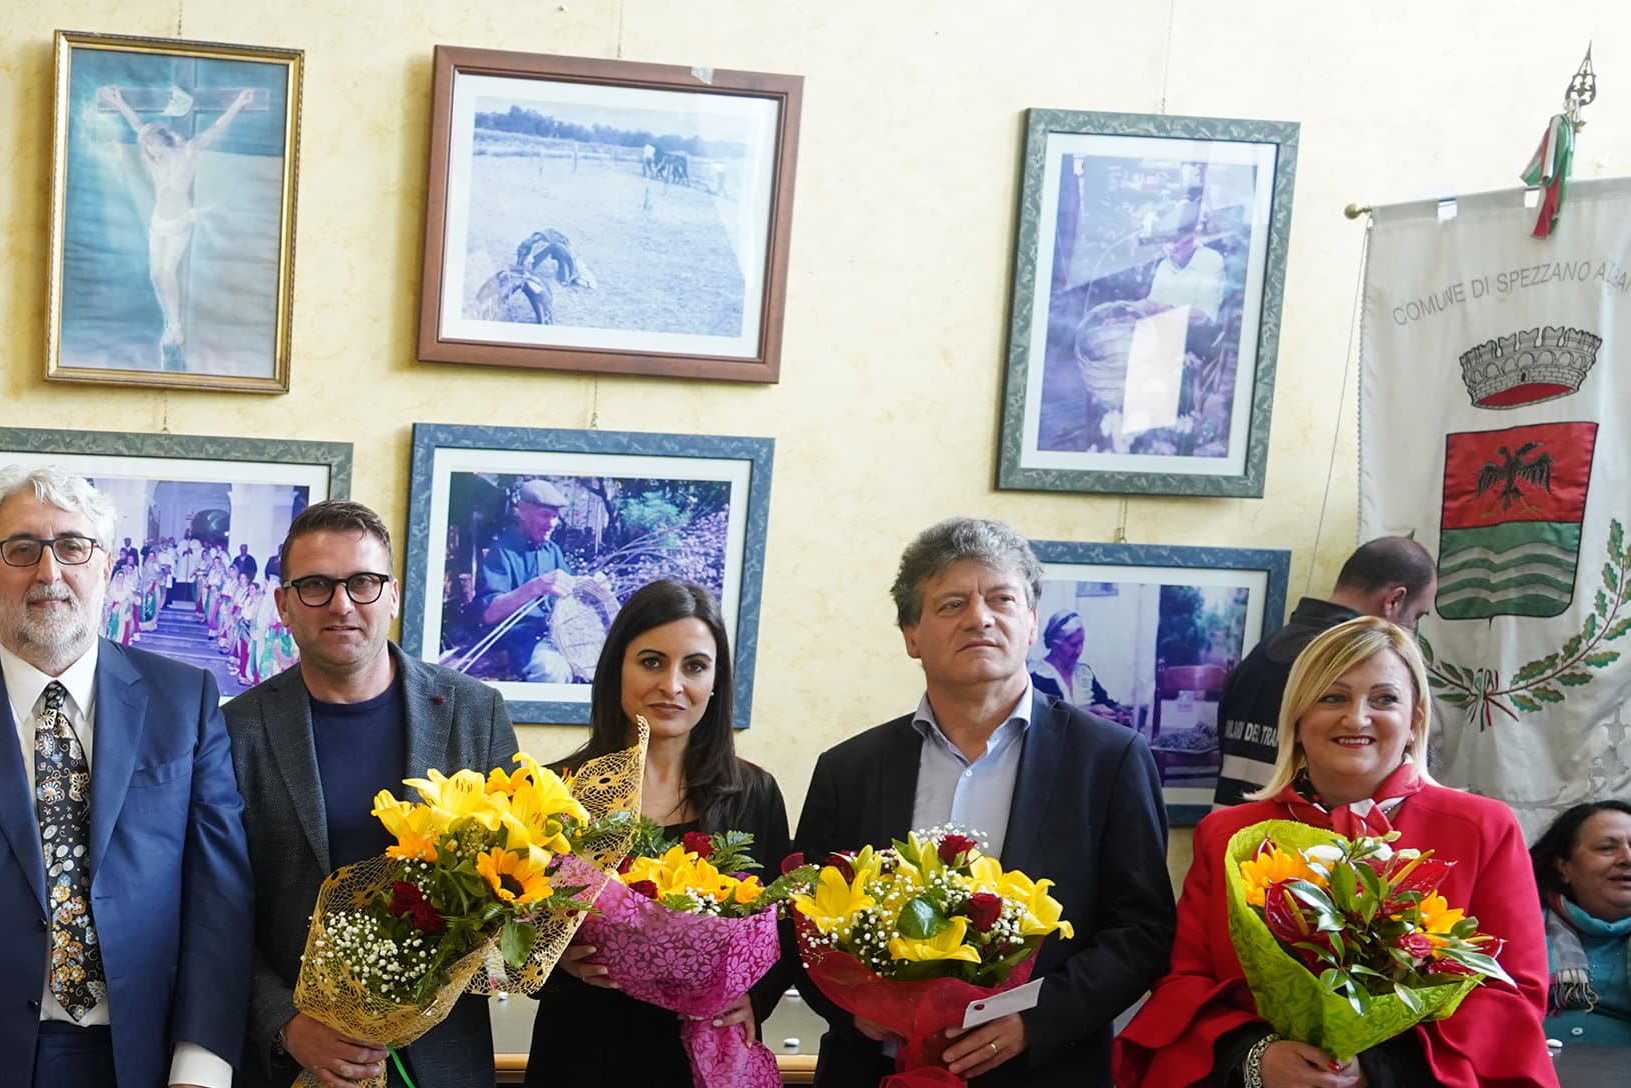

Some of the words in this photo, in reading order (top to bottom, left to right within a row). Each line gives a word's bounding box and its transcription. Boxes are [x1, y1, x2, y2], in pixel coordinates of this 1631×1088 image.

[1392, 282, 1467, 326] COMUNE
[1471, 275, 1490, 299] DI
[1496, 260, 1590, 295] SPEZZANO
